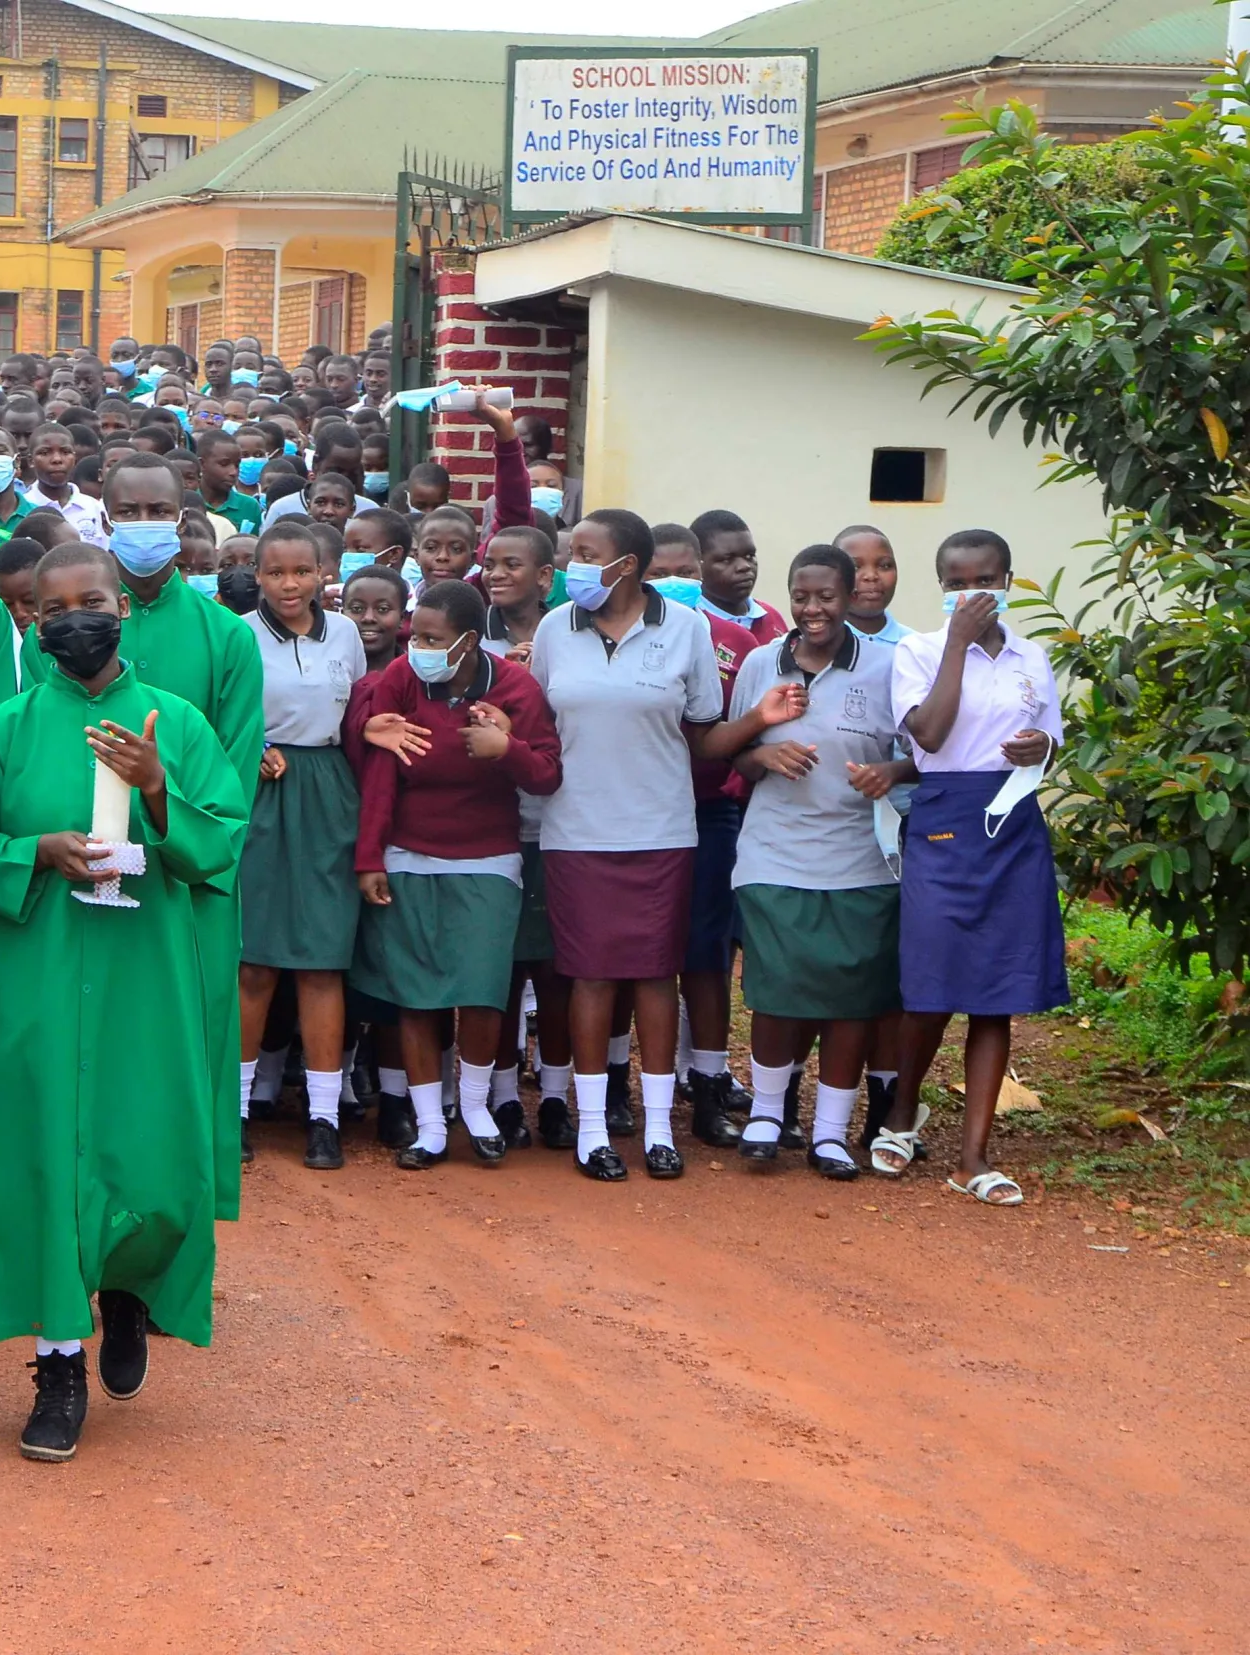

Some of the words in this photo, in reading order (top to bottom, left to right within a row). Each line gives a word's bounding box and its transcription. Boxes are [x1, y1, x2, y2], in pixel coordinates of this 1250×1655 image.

[572, 66, 656, 90] SCHOOL
[662, 64, 751, 86] MISSION:
[570, 98, 630, 119] Foster
[635, 94, 716, 122] Integrity,
[722, 94, 798, 116] Wisdom
[524, 130, 562, 153] And
[568, 127, 647, 156] Physical
[654, 126, 721, 149] Fitness
[728, 124, 759, 146] For
[765, 123, 799, 145] The
[516, 159, 587, 184] Service
[592, 157, 615, 181] Of
[619, 157, 659, 180] God
[663, 156, 702, 179] And
